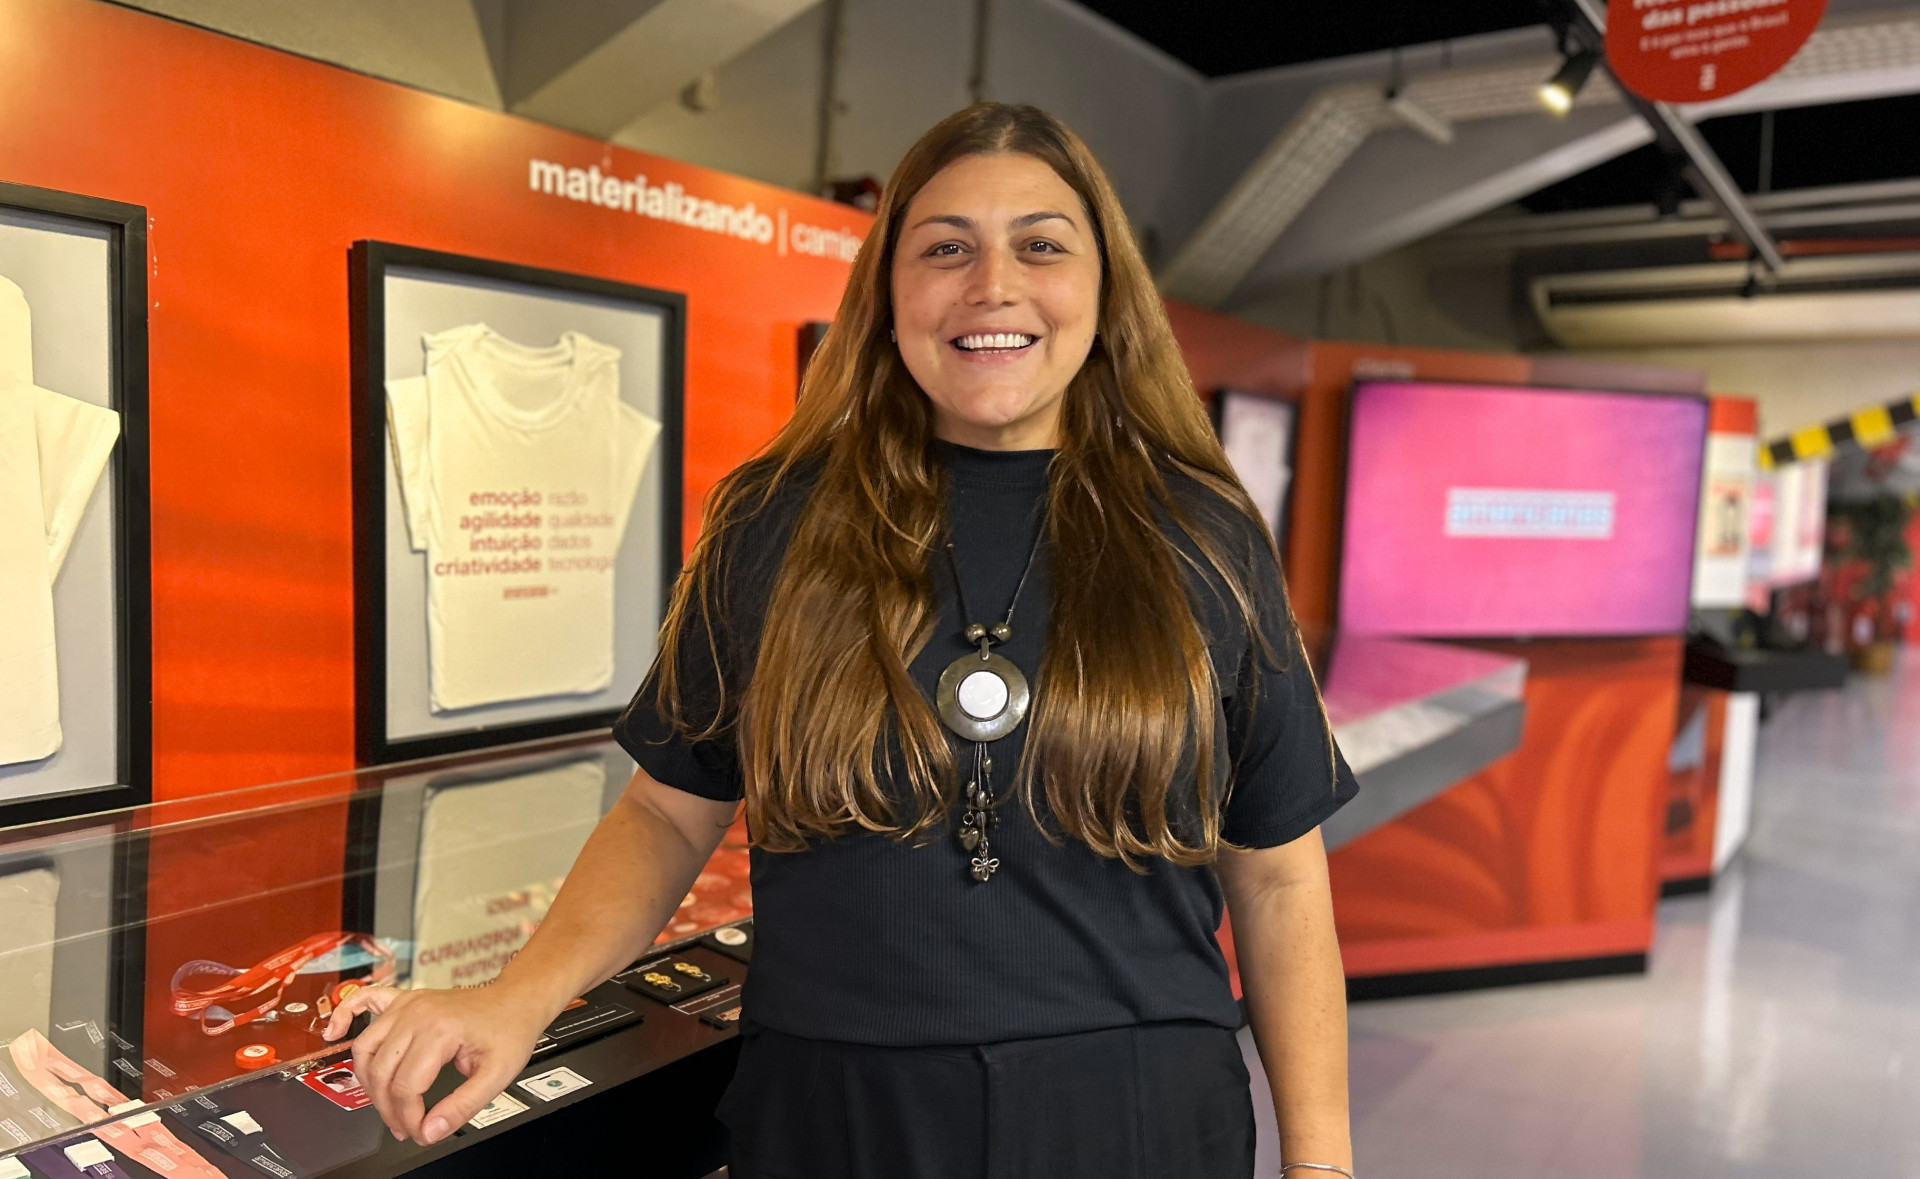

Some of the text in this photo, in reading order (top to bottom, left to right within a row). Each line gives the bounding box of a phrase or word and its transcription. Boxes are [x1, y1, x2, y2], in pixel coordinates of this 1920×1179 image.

[1641, 7, 1684, 30] das
[529, 157, 774, 244] materializando
[469, 487, 542, 508] emoção
[459, 511, 542, 532] agilidade
[469, 533, 542, 554] intuição
[434, 554, 541, 576] criatividade
